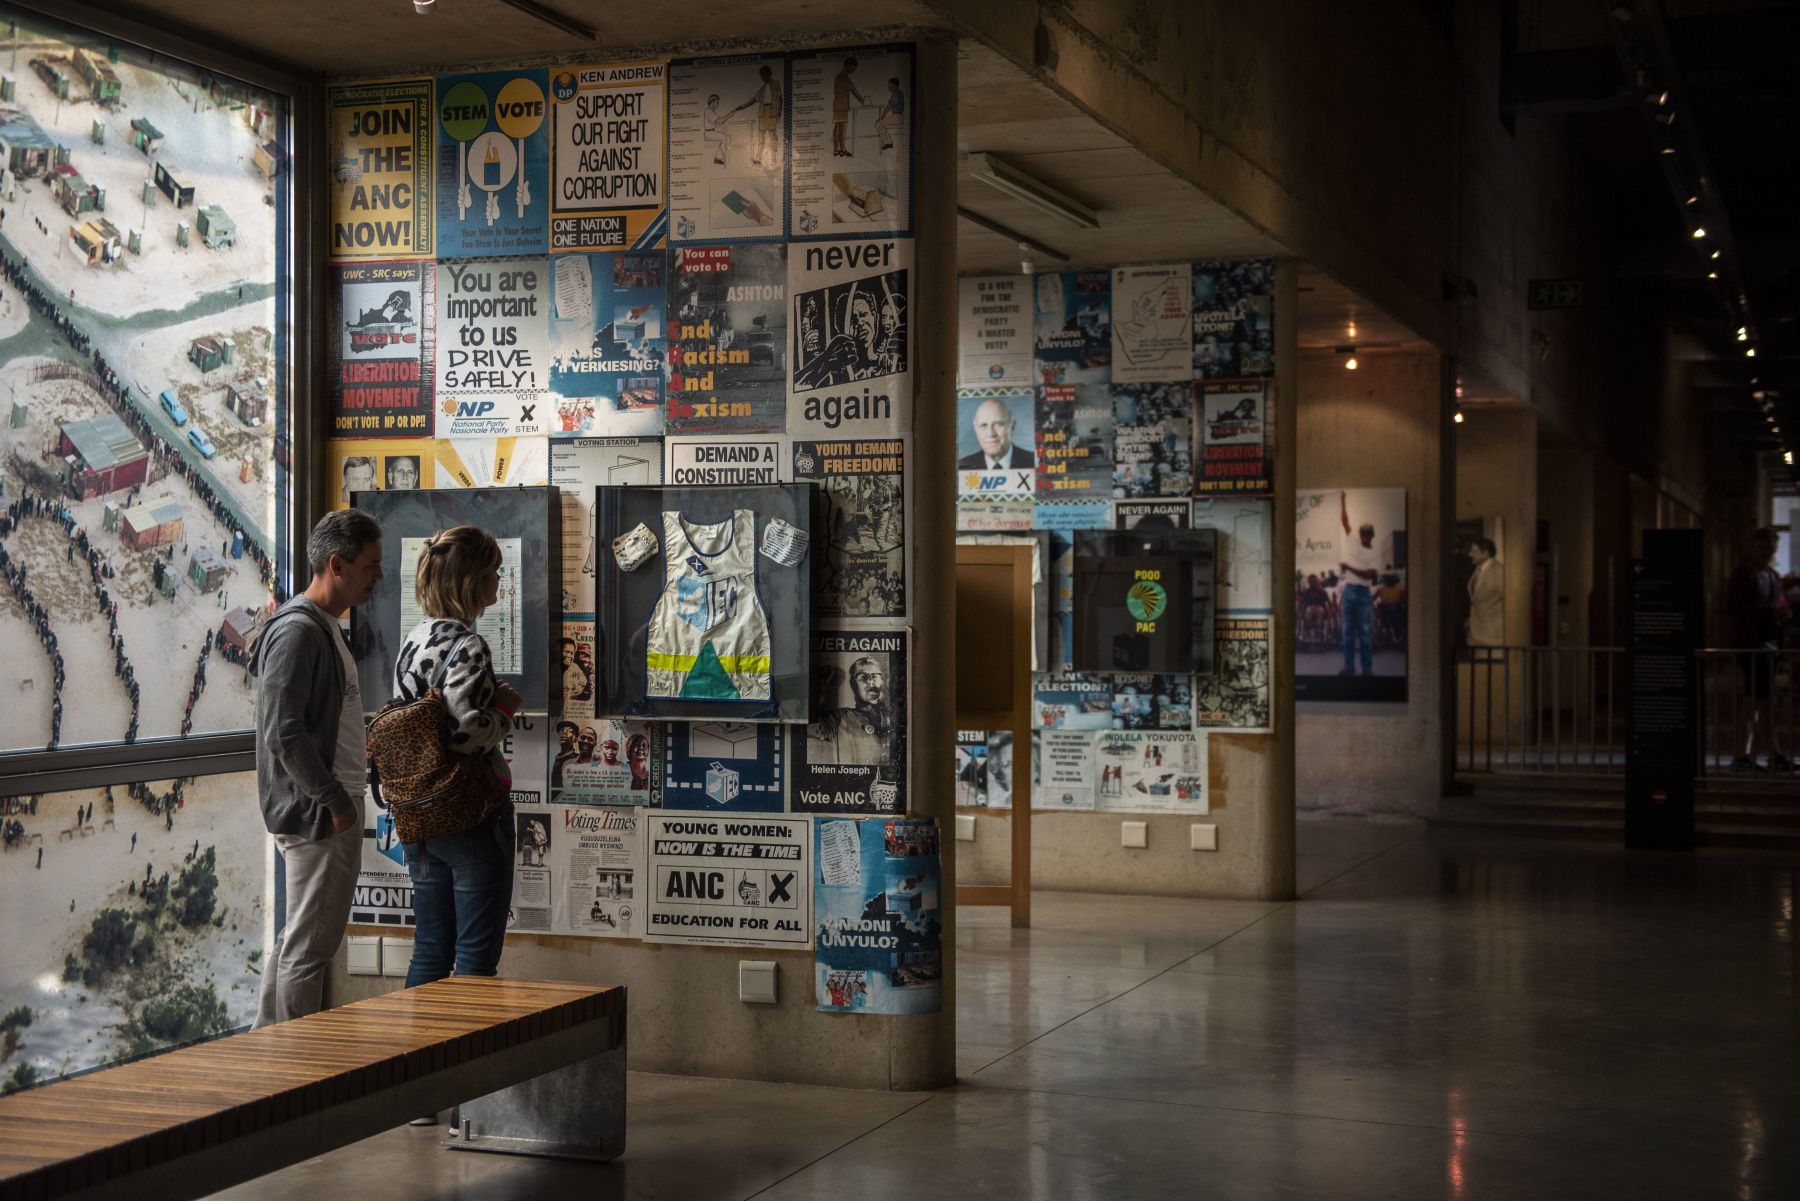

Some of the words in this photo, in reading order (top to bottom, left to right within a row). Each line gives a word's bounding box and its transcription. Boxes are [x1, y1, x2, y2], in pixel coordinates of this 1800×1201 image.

[580, 71, 605, 83] KEN
[609, 65, 664, 81] ANDREW
[559, 88, 573, 98] DP
[443, 104, 487, 122] STEM
[498, 101, 543, 119] VOTE
[576, 92, 645, 119] SUPPORT
[348, 108, 410, 137] JOIN
[572, 123, 603, 146] OUR
[607, 119, 649, 144] FIGHT
[358, 145, 412, 173] THE
[578, 147, 642, 172] AGAINST
[563, 173, 657, 200] CORRUPTION
[350, 183, 411, 211] ANC
[553, 219, 577, 232] ONE
[580, 217, 620, 231] NATION
[335, 221, 411, 248] NOW!
[553, 234, 577, 246] ONE
[580, 232, 624, 245] FUTURE
[684, 248, 706, 258] You
[709, 248, 729, 258] can
[806, 241, 895, 271] never
[343, 269, 365, 280] UWC
[372, 268, 391, 280] SRC
[391, 269, 416, 280] says:
[685, 263, 712, 273] vote
[716, 262, 729, 272] to
[447, 265, 491, 293] You
[498, 270, 537, 292] are
[727, 286, 784, 301] ASHTON
[447, 293, 537, 326] important
[459, 323, 485, 346] to
[492, 325, 518, 345] us
[668, 319, 712, 340] End
[448, 350, 532, 368] DRIVE
[668, 345, 751, 366] Racism
[342, 361, 421, 384] LIBERATION
[572, 359, 660, 374] VERKIESING?
[445, 371, 536, 388] SAFELY!
[668, 371, 715, 392] And
[342, 387, 419, 409] MOVEMENT
[515, 393, 539, 401] VOTE
[456, 401, 495, 417] NP
[804, 388, 892, 429] again
[336, 416, 359, 429] DON'T
[361, 416, 380, 429] VOTE
[384, 416, 395, 428] NP
[397, 415, 408, 428] OR
[452, 420, 485, 428] National
[486, 420, 507, 429] Party
[449, 428, 488, 436] Nasionale
[695, 447, 760, 463] DEMAND
[762, 446, 774, 463] A
[815, 443, 852, 457] YOUTH
[854, 441, 903, 456] DEMAND
[496, 457, 505, 480] POWER
[823, 457, 903, 474] FREEDOM!
[674, 468, 774, 485] CONSTITUENT
[979, 476, 1007, 490] NP
[1118, 505, 1150, 515] NEVER
[1152, 505, 1186, 515] AGAIN!
[705, 575, 739, 632] IEC
[1136, 621, 1156, 633] PAC
[848, 637, 901, 651] AGAIN!
[1037, 682, 1108, 692] ELECTION?
[957, 730, 985, 742] STEM
[1105, 733, 1143, 742] INDLELA
[1146, 733, 1197, 742] YOKUVOTA
[652, 760, 661, 788] CREDIT
[811, 764, 836, 774] Helen
[837, 765, 870, 777] Joseph
[509, 792, 539, 803] EEDOM
[800, 790, 831, 804] Vote
[830, 791, 865, 805] ANC
[564, 810, 600, 832] Voting
[602, 810, 637, 829] Times
[663, 823, 719, 835] YOUNG
[725, 825, 792, 838] WOMEN:
[656, 840, 699, 855] NOW
[701, 842, 717, 856] IS
[721, 843, 754, 857] THE
[760, 845, 800, 859] TIME
[666, 871, 725, 900] ANC
[352, 886, 415, 909] MONI
[652, 914, 734, 927] EDUCATION
[739, 918, 768, 930] FOR
[774, 920, 802, 931] ALL
[821, 935, 899, 949] UNYULO?
